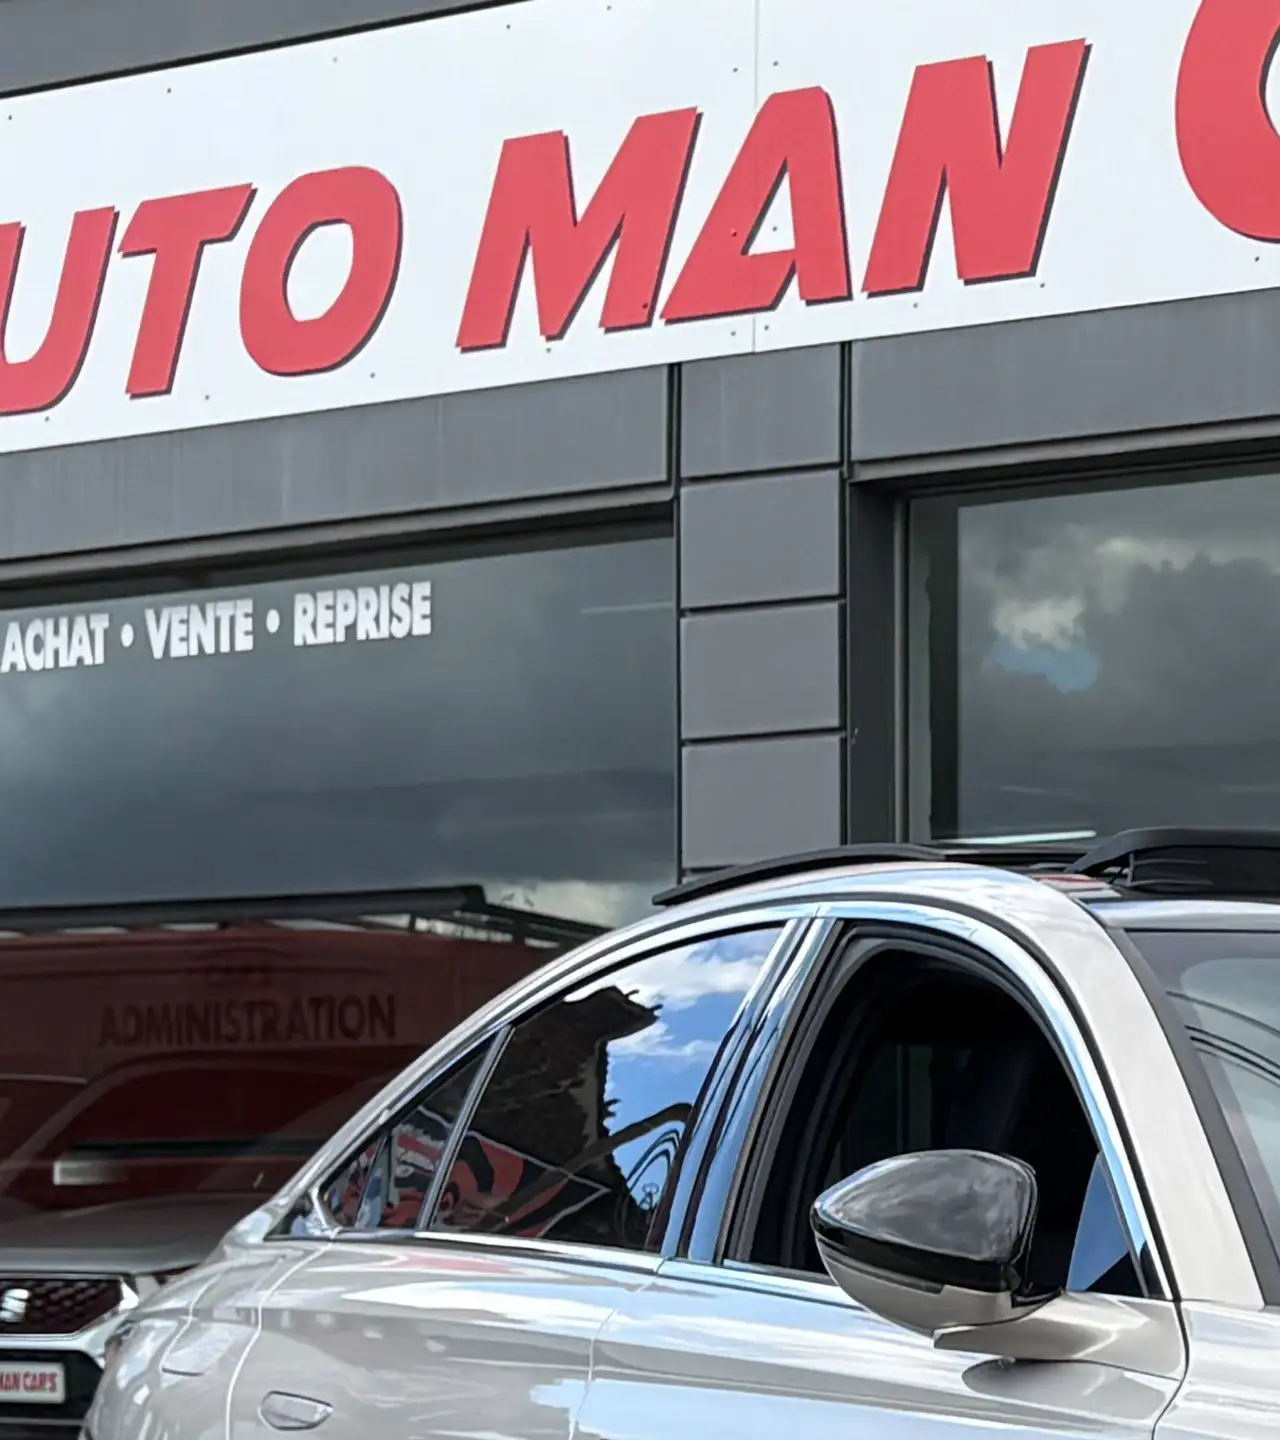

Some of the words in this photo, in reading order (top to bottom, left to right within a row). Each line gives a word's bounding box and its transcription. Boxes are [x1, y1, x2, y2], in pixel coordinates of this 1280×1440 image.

[455, 37, 1092, 352] MAN
[0, 613, 110, 675] ACHAT
[145, 598, 253, 660] VENTE
[293, 581, 433, 647] REPRISE
[98, 994, 396, 1049] ADMINISTRATION
